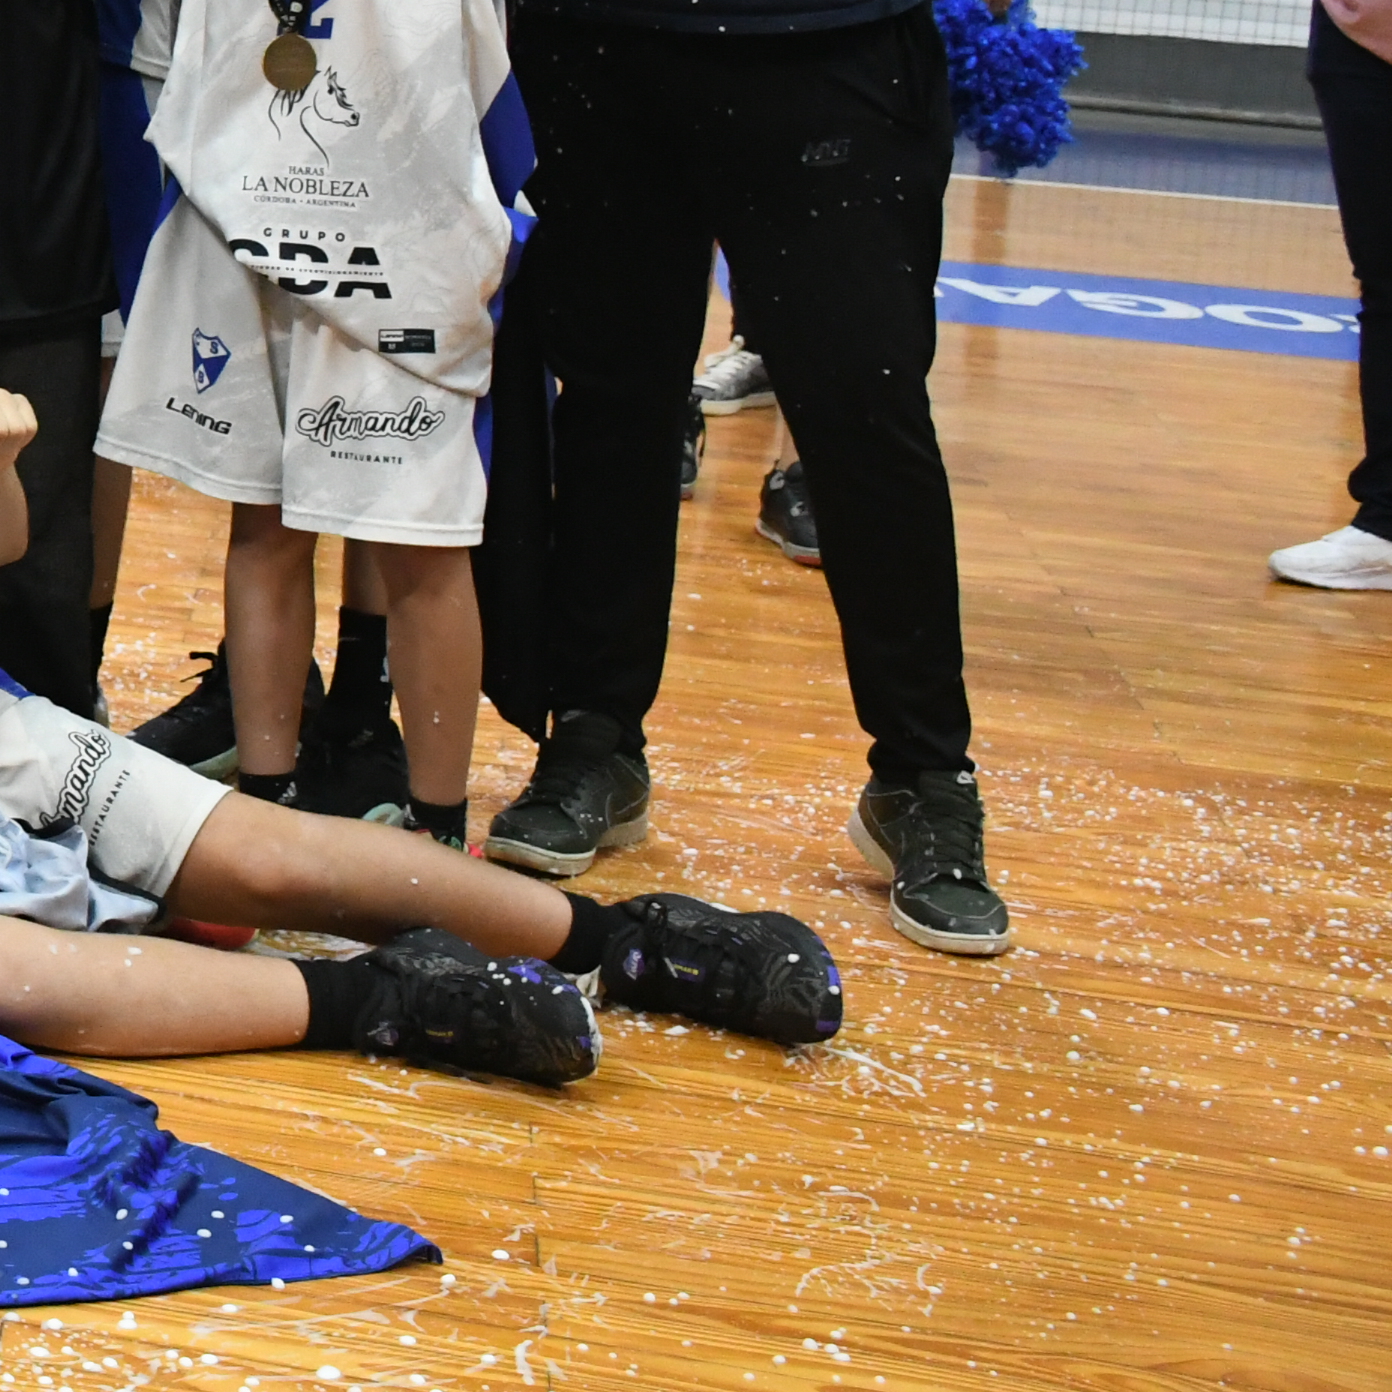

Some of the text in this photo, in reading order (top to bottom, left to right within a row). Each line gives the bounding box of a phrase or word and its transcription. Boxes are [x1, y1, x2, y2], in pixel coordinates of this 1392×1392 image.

[288, 165, 325, 177] HARAS
[242, 175, 370, 198] LA NOBLEZA
[263, 227, 346, 243] GRUPO
[296, 396, 446, 448] Armando
[330, 449, 404, 466] RESTAURANTE
